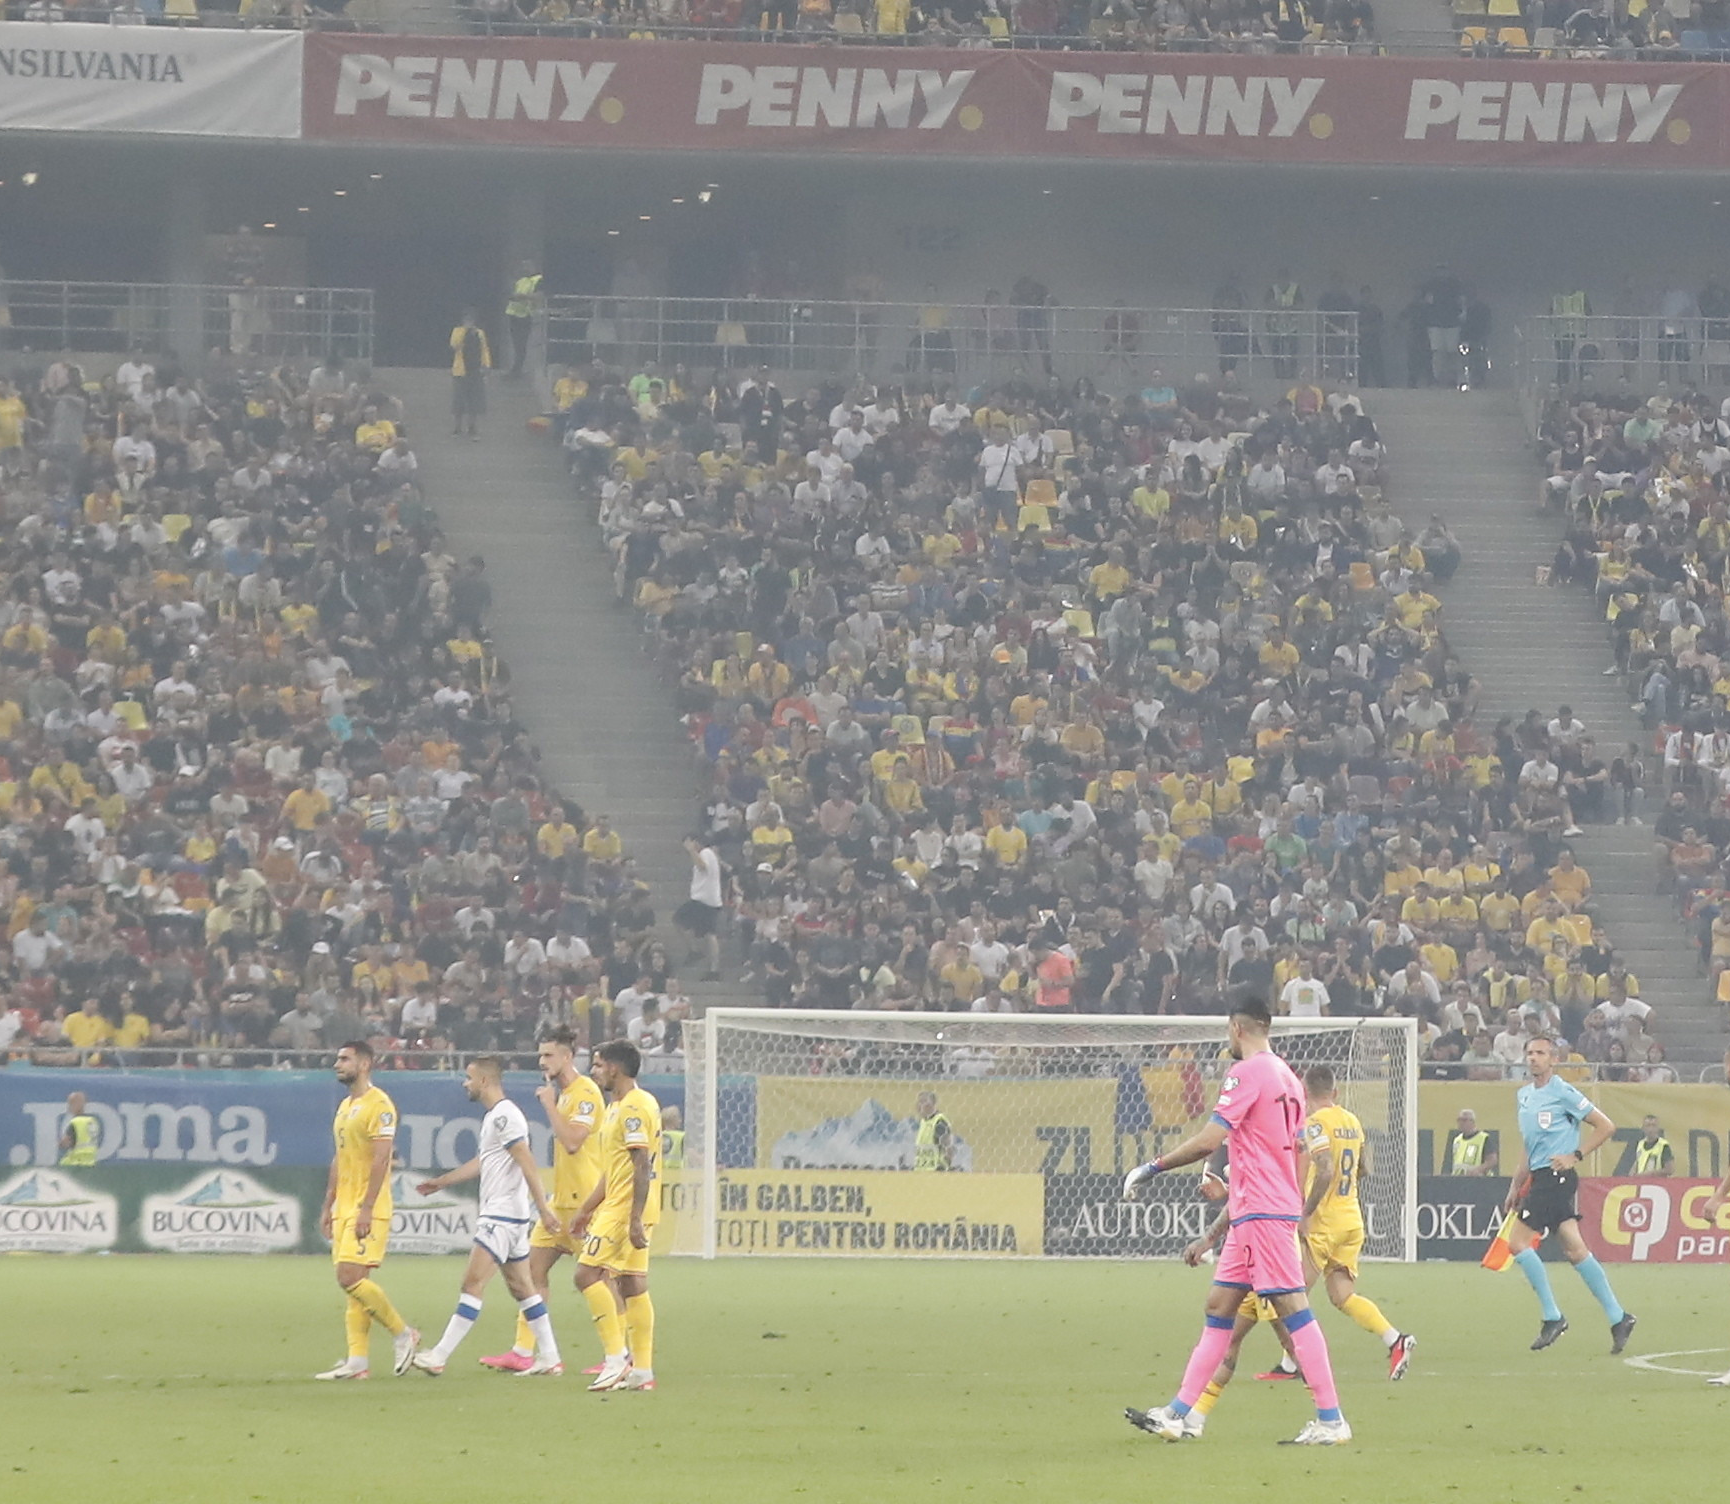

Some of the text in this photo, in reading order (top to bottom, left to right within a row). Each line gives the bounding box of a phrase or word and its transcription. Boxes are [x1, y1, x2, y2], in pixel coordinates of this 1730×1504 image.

[334, 54, 616, 122] PENNY
[695, 63, 975, 130] PENNY
[1046, 71, 1325, 138] PENNY
[1403, 77, 1684, 144] PENNY
[152, 1210, 290, 1234] BUCOVINA
[389, 1212, 469, 1235] OVINA
[776, 1220, 886, 1249] PENTRU
[894, 1216, 1018, 1252] ROMÂNIA
